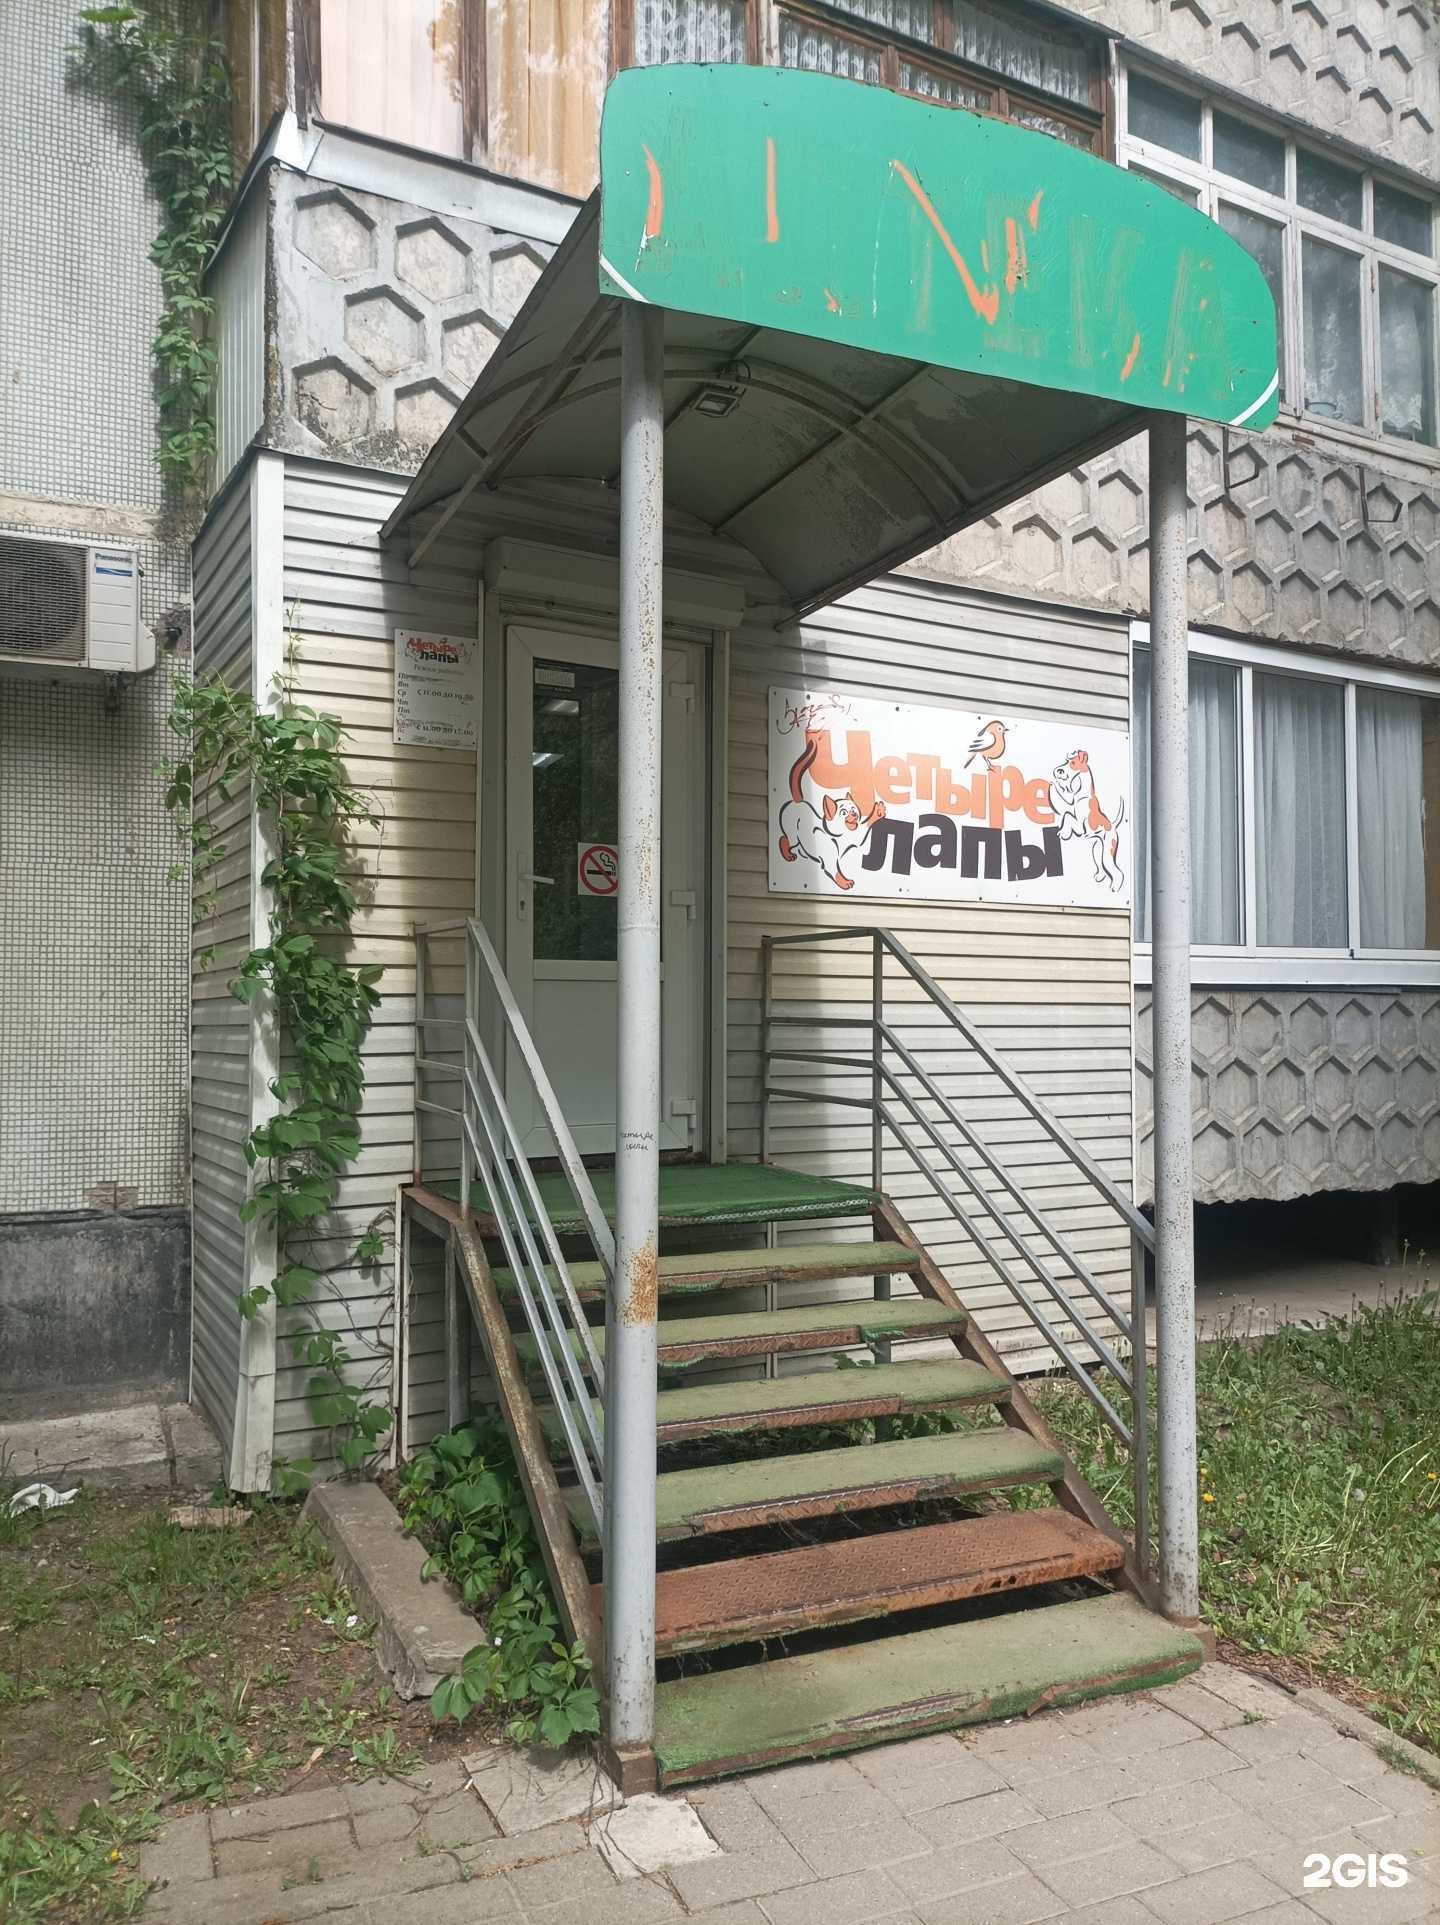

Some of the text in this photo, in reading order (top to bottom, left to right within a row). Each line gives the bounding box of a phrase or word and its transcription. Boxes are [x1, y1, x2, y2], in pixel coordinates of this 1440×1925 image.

[419, 651, 460, 664] лапы
[806, 730, 1055, 829] Четыре
[862, 813, 1064, 882] лапы
